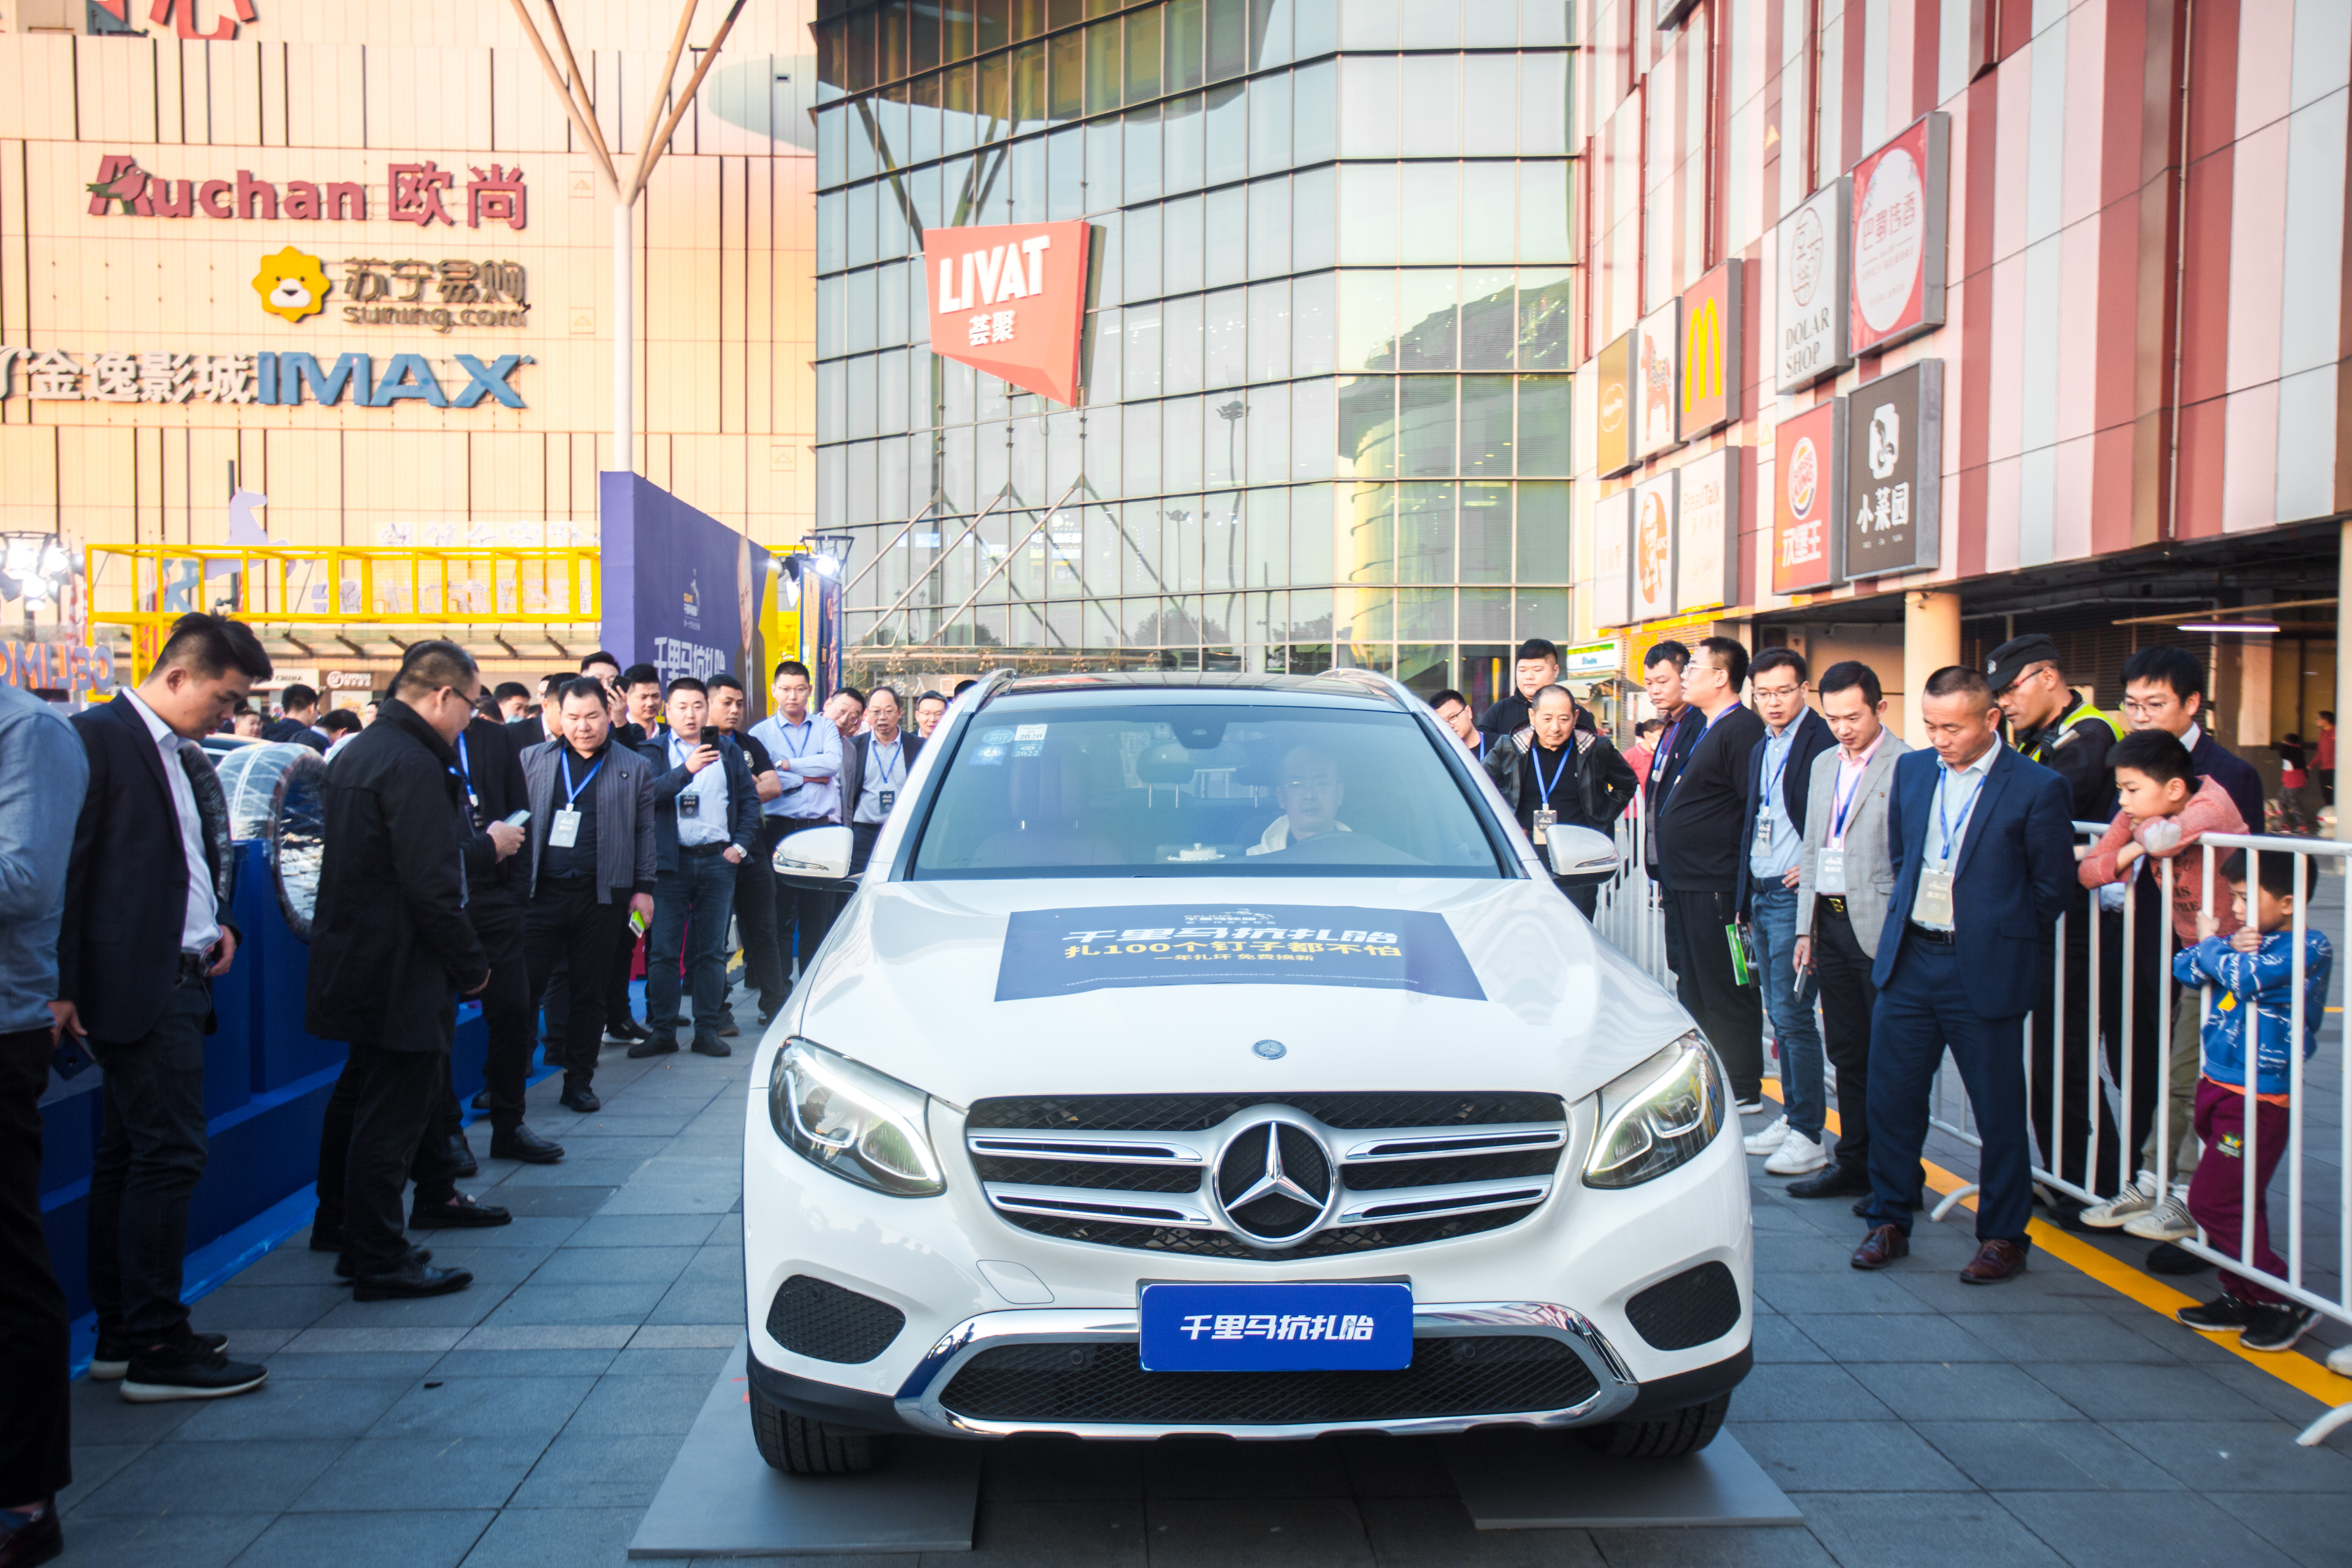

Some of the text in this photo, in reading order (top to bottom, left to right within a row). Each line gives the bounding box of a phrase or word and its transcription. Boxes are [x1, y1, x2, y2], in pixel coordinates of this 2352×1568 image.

[86, 155, 527, 229] Auchan 欧尚
[343, 257, 527, 303] 苏宁易购
[939, 236, 1050, 314] LIVAT
[343, 303, 528, 334] suning.com
[969, 310, 1016, 346] 荟聚
[1785, 307, 1829, 350] DOLAR
[27, 347, 527, 408] 金逸影城 IMAX
[1785, 341, 1821, 378] SHOP
[1856, 481, 1910, 534] 小菜园
[1782, 519, 1822, 568] 汉堡王
[1062, 927, 1398, 944] 千里马抗扎胎
[1064, 941, 1402, 959] 扎100个钉子都不怕
[1180, 1314, 1375, 1340] 千里马抗扎胎
